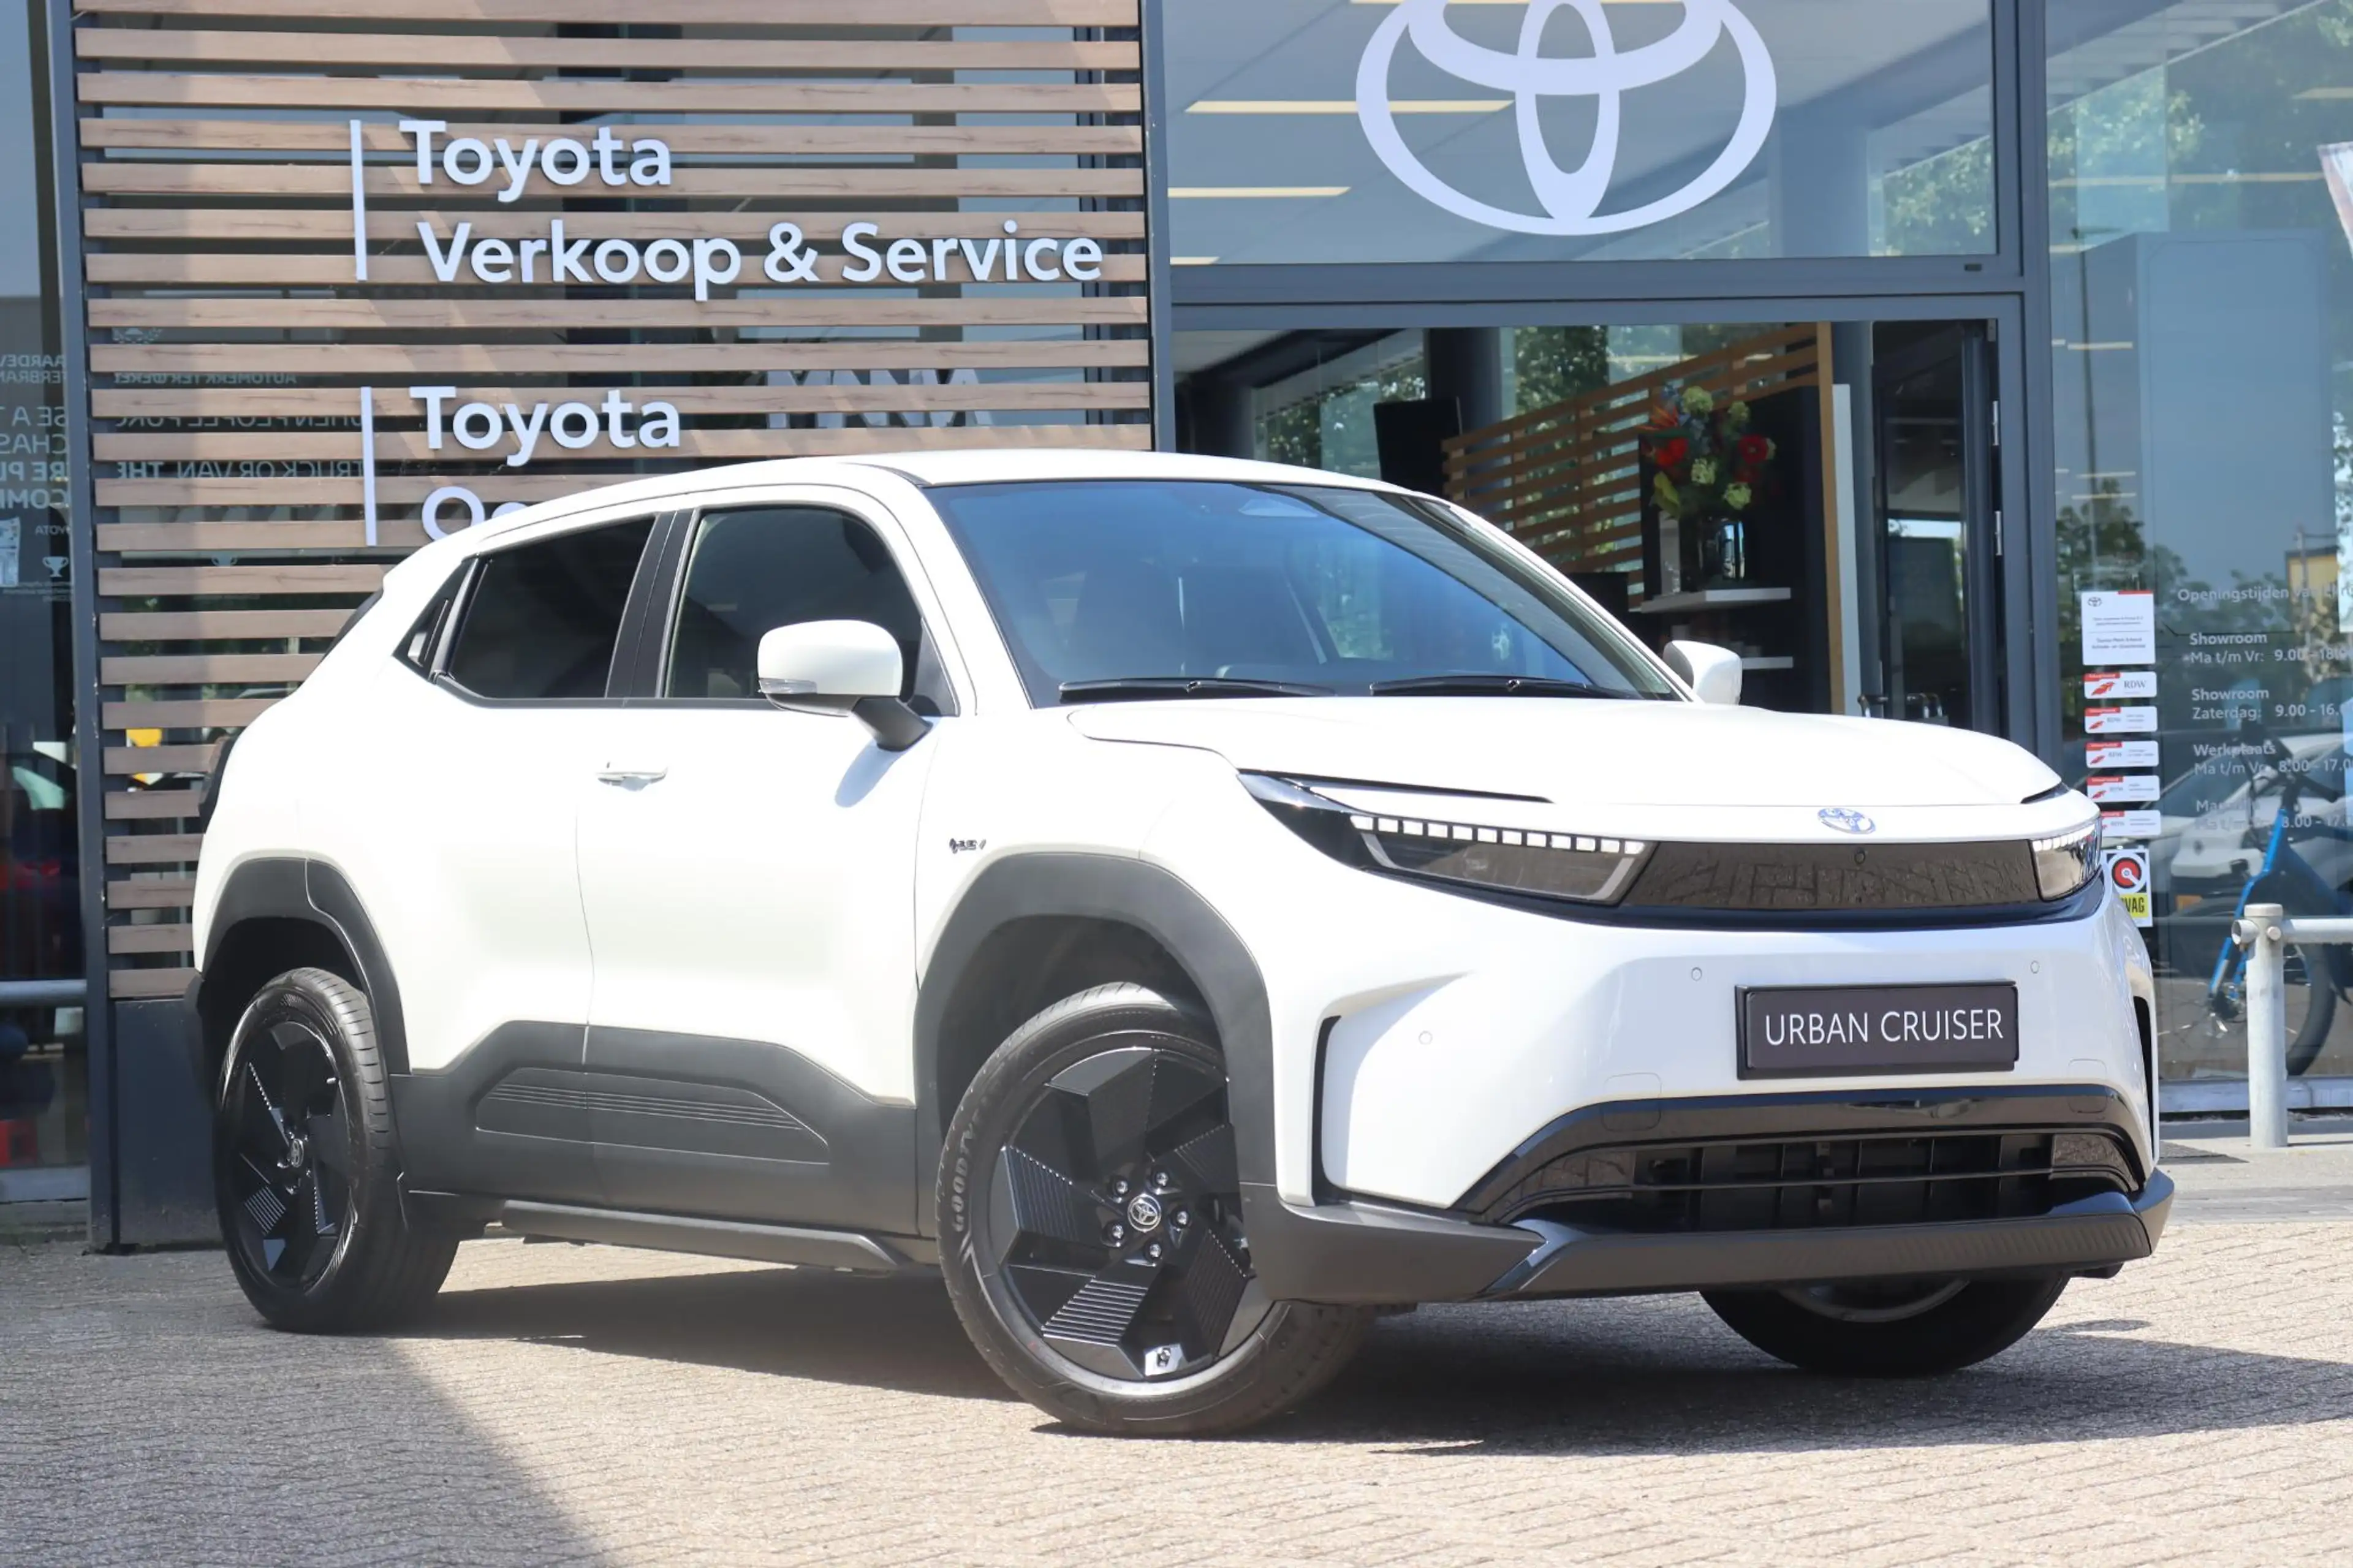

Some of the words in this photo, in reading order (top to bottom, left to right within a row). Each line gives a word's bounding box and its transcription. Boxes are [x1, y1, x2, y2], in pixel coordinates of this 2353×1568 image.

[399, 119, 672, 203] Toyota
[416, 219, 741, 301] Verkoop
[763, 221, 820, 283] &
[841, 219, 1103, 282] Service
[409, 385, 680, 467] Toyota
[2178, 586, 2289, 603] Openingstijden
[2189, 632, 2267, 645] Showroom
[2191, 652, 2211, 664] Ma
[2216, 650, 2241, 666] t/m
[2123, 680, 2146, 689] RDW
[2191, 689, 2269, 701] Showroom
[2192, 707, 2262, 721] Zaterdag:
[2275, 704, 2306, 717] 9.00
[2194, 763, 2216, 775] Ma
[2220, 762, 2245, 776] t/m
[2121, 896, 2146, 913] VAG
[1765, 1012, 1868, 1046] URBAN
[1881, 1009, 2004, 1042] CRUISER
